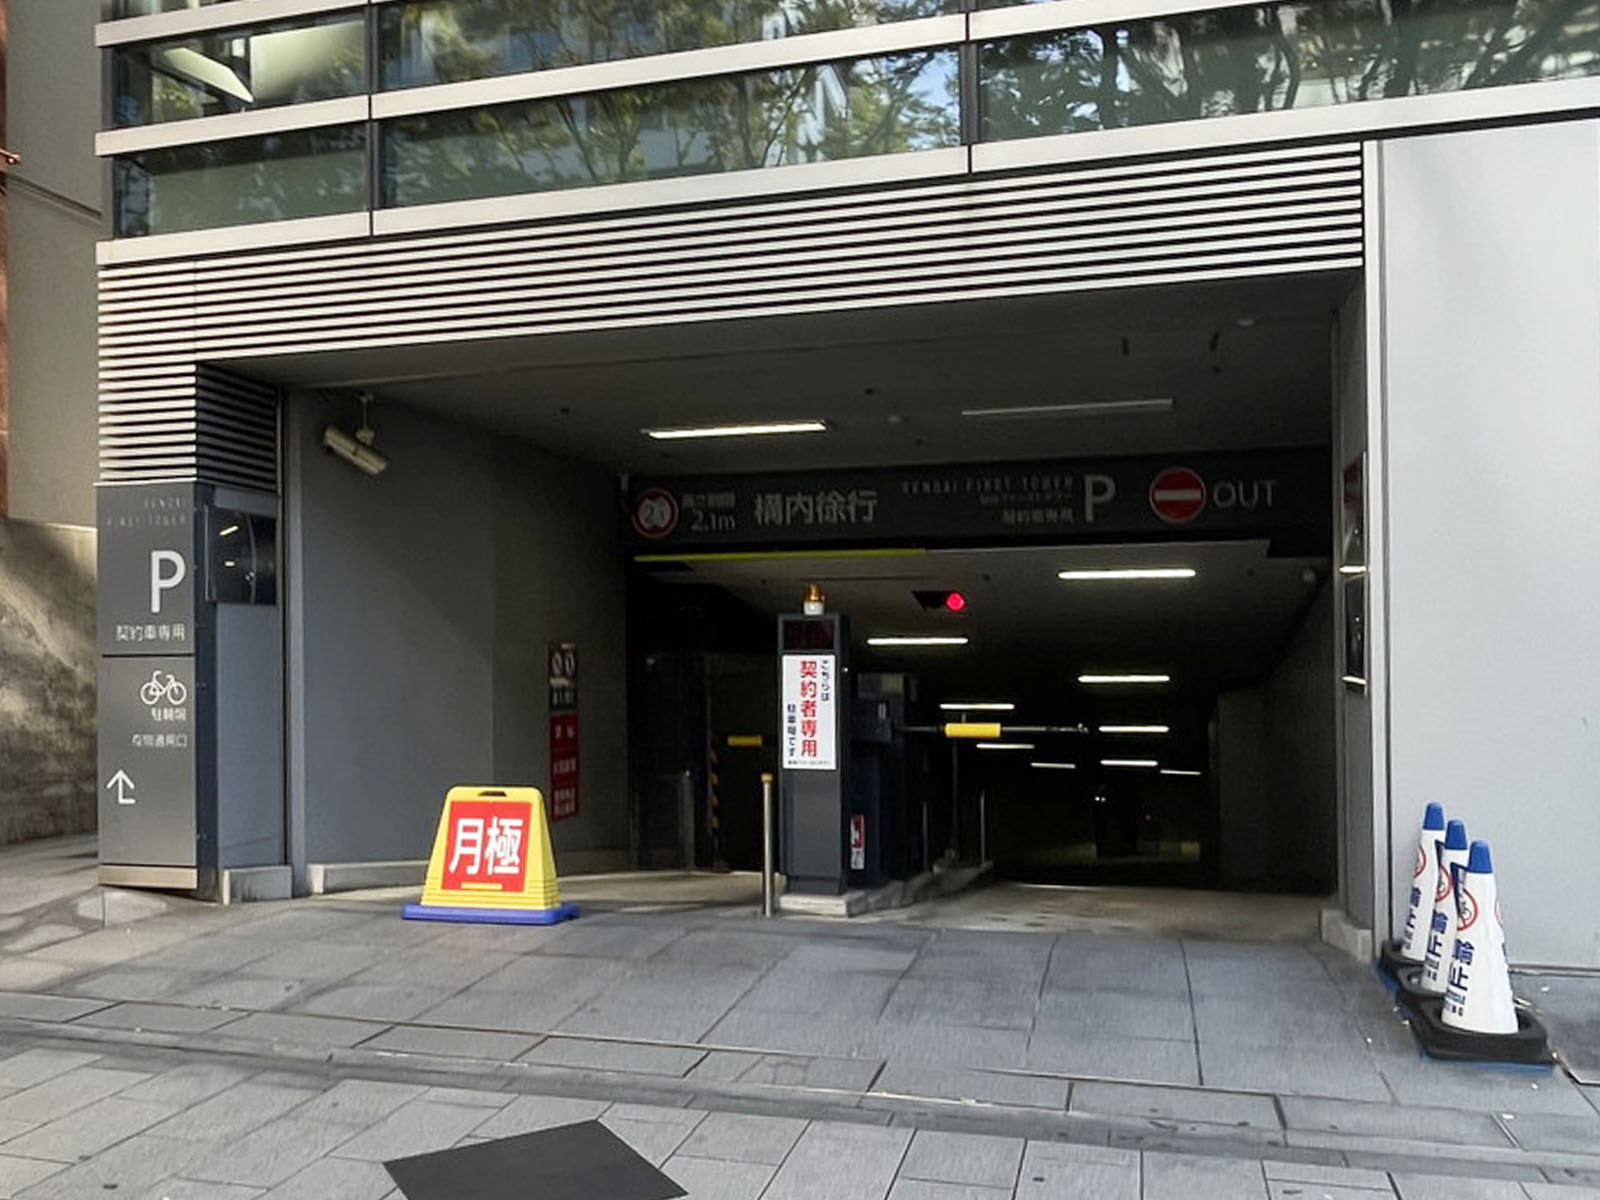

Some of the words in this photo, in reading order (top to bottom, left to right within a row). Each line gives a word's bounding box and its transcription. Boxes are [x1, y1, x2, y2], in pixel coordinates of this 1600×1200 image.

[1085, 475, 1116, 523] P
[1213, 479, 1277, 509] OUT
[150, 550, 186, 613] P
[800, 660, 817, 757] 契約者専用
[448, 816, 524, 875] 月極
